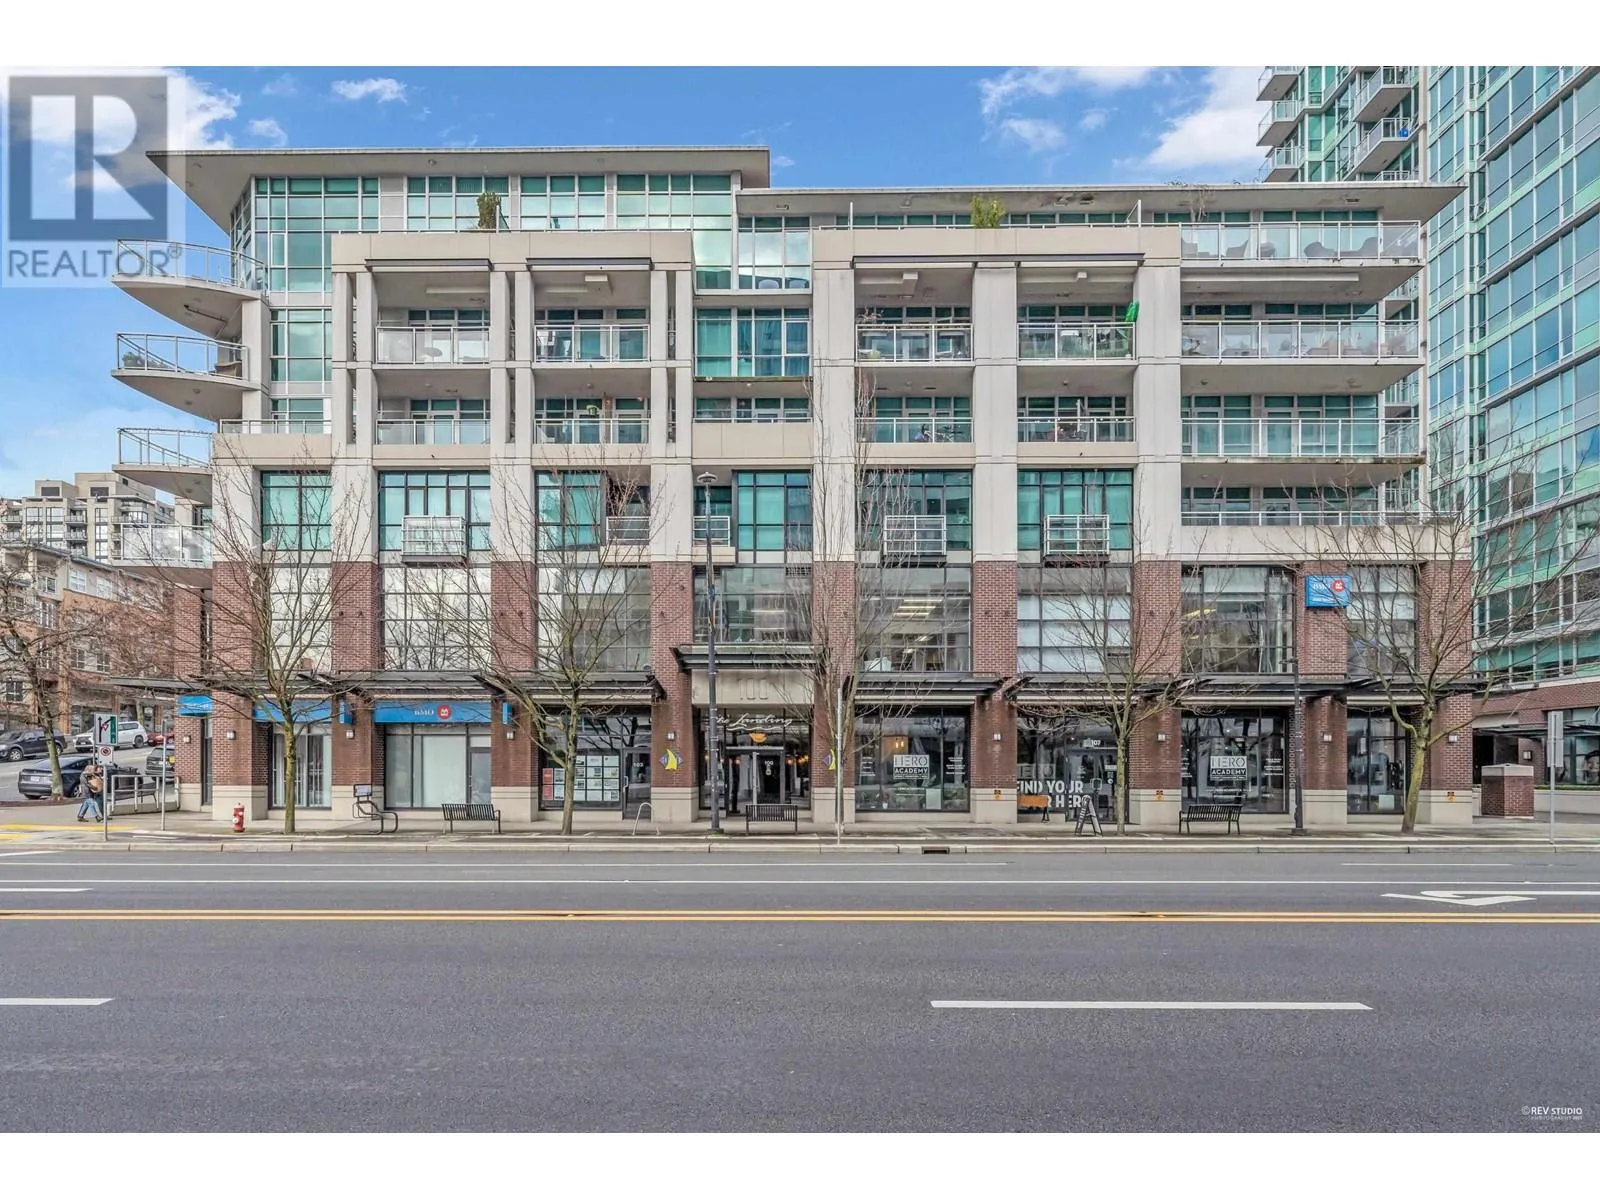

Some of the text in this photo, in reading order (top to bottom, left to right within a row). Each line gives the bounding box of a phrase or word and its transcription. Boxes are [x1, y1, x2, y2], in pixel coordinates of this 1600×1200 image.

[739, 678, 768, 700] 100
[729, 712, 793, 727] Landing
[895, 755, 928, 766] HERO
[1212, 757, 1246, 767] HERO
[1017, 780, 1043, 794] IND
